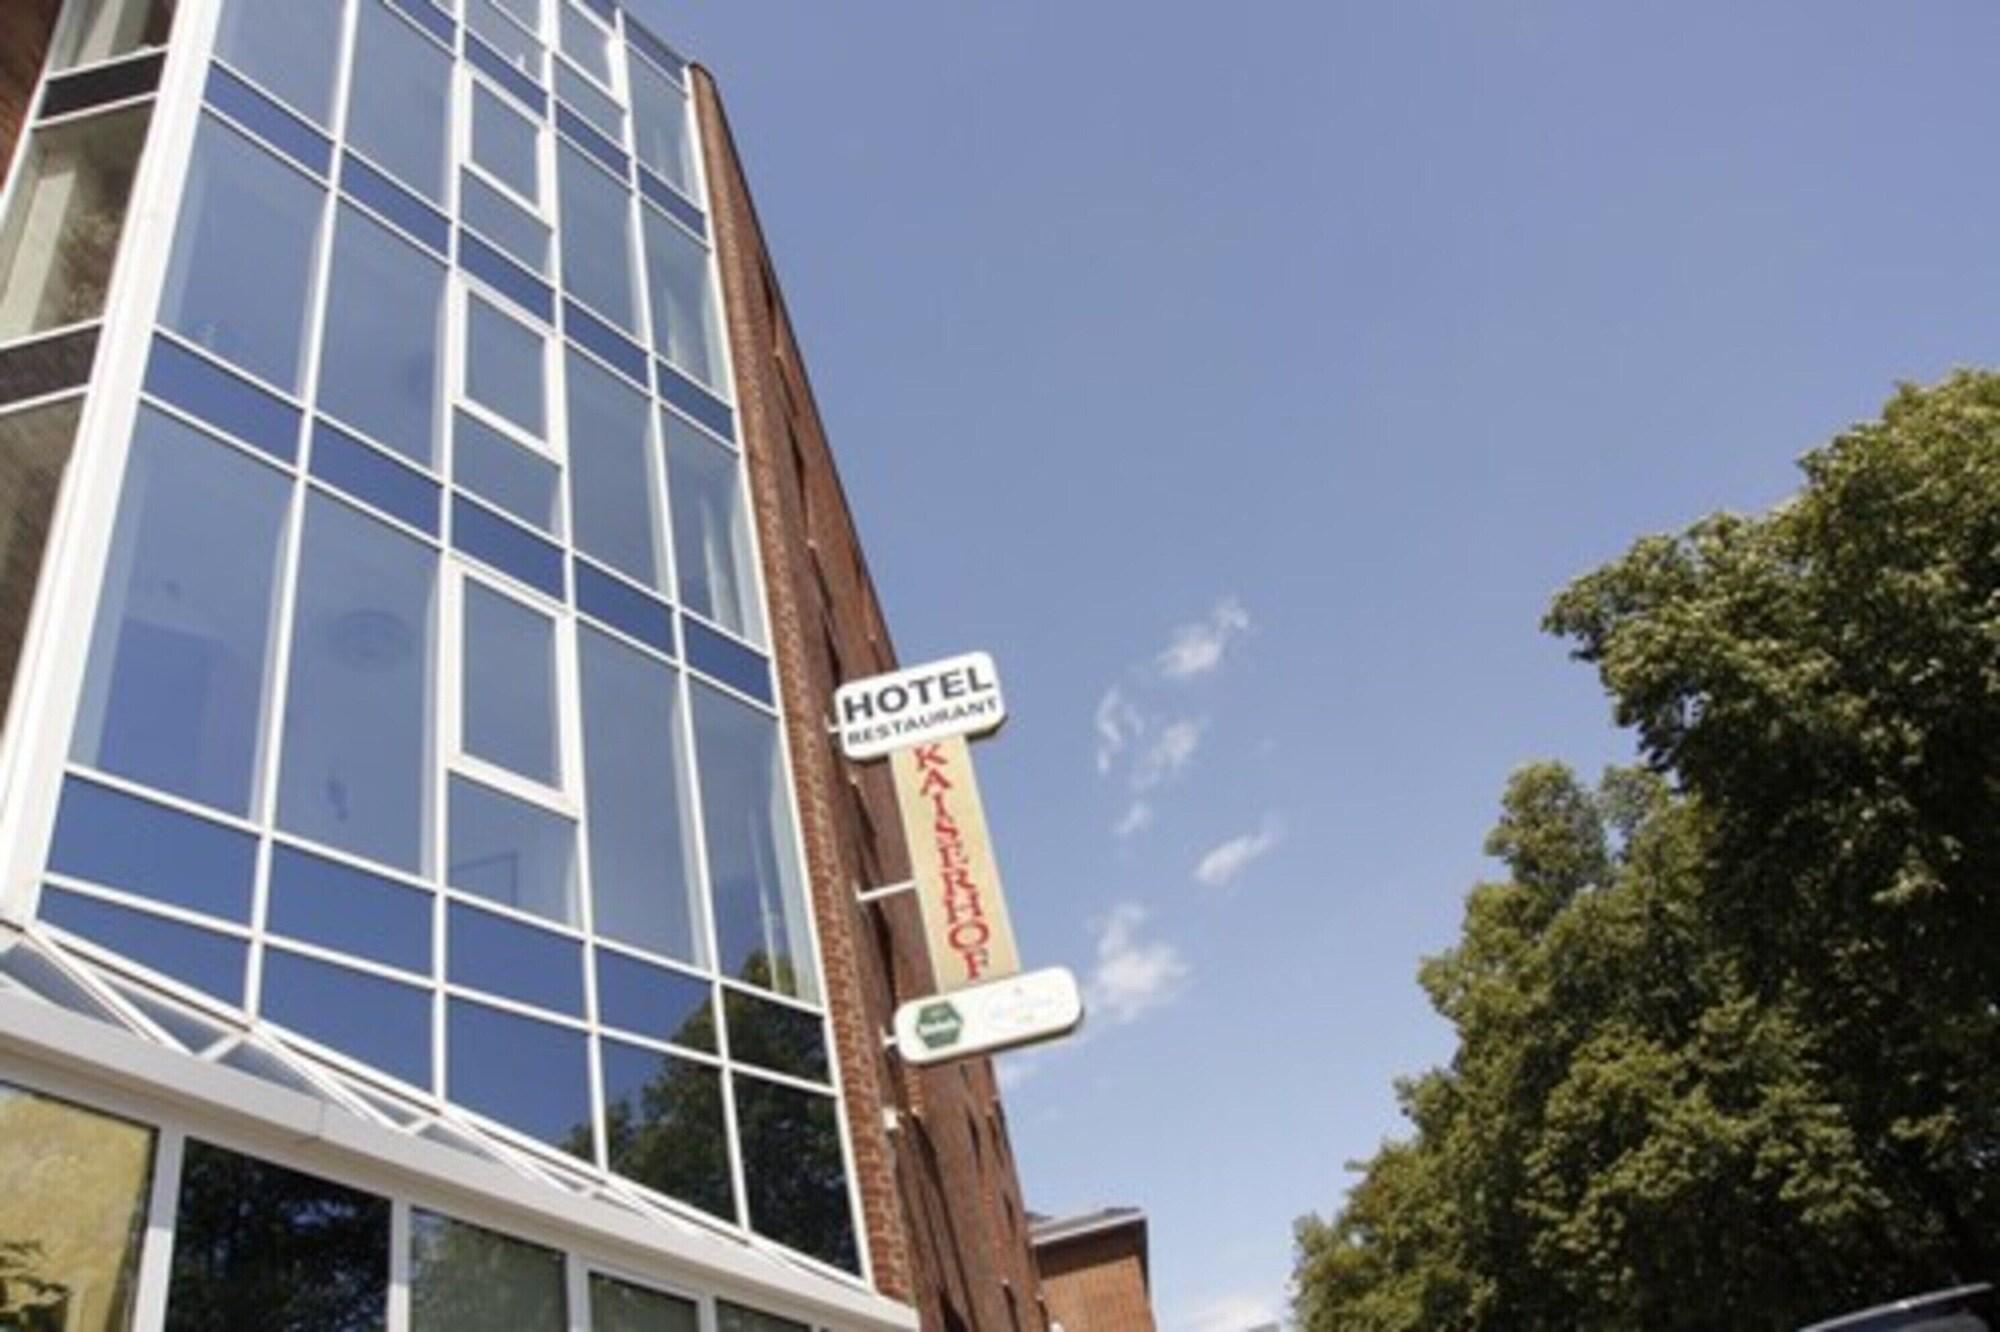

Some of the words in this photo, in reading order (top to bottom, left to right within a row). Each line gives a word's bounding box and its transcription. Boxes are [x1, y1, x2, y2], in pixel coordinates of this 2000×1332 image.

[843, 667, 993, 722] HOTEL
[848, 697, 996, 743] RESTAURANT
[914, 743, 989, 980] KAISERHOF
